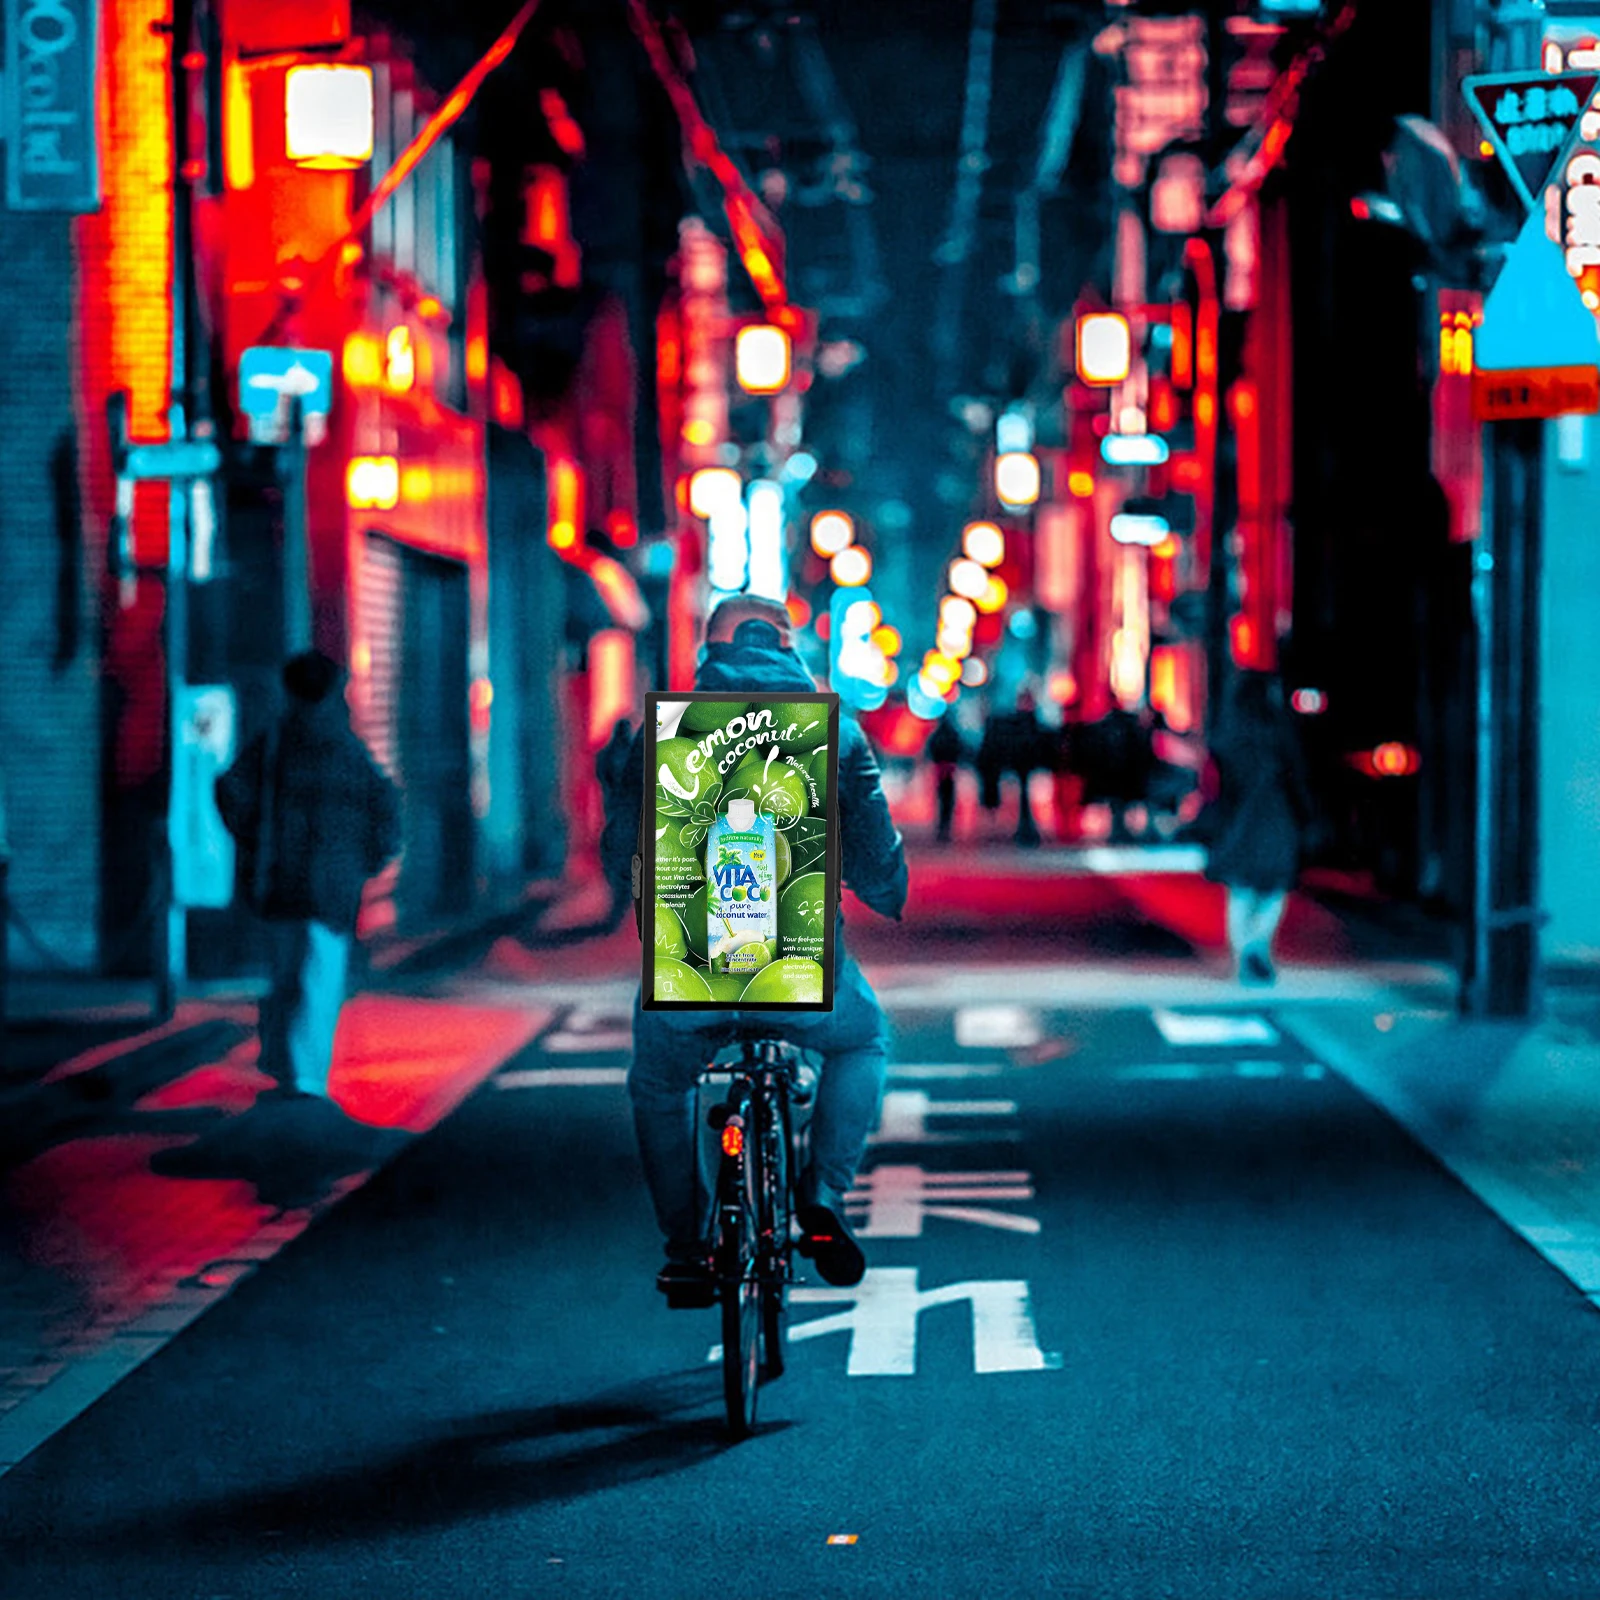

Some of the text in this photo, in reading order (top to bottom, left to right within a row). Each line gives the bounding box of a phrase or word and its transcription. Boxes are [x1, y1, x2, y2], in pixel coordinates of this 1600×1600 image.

[658, 709, 778, 801] Lemon
[718, 720, 819, 775] coconut!
[785, 755, 820, 808] Natural health
[712, 863, 758, 887] VITA
[720, 883, 771, 902] COCO
[715, 911, 767, 919] coconut water
[730, 903, 751, 912] pure
